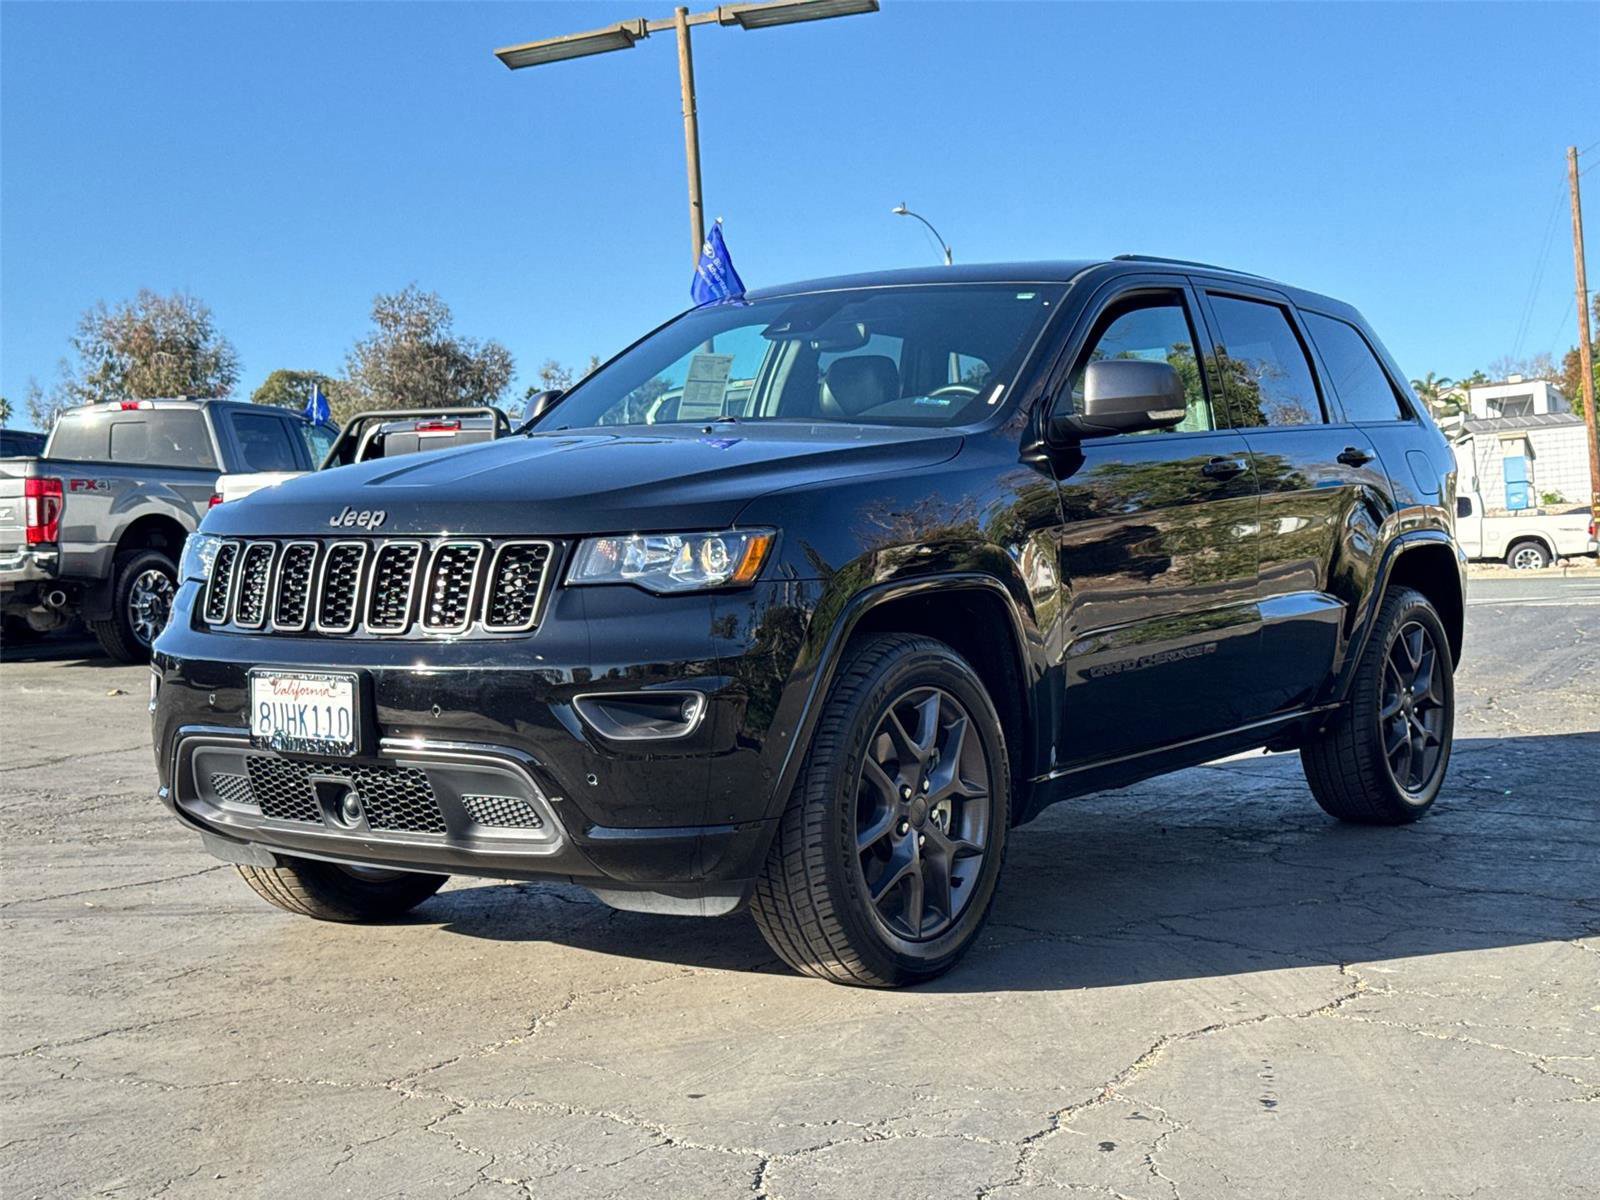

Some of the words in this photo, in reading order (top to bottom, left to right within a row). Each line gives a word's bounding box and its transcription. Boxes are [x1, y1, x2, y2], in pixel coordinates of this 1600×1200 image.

[70, 479, 112, 491] FX4
[329, 506, 386, 530] Jeep
[272, 679, 336, 701] California
[259, 701, 350, 739] 8UHK110
